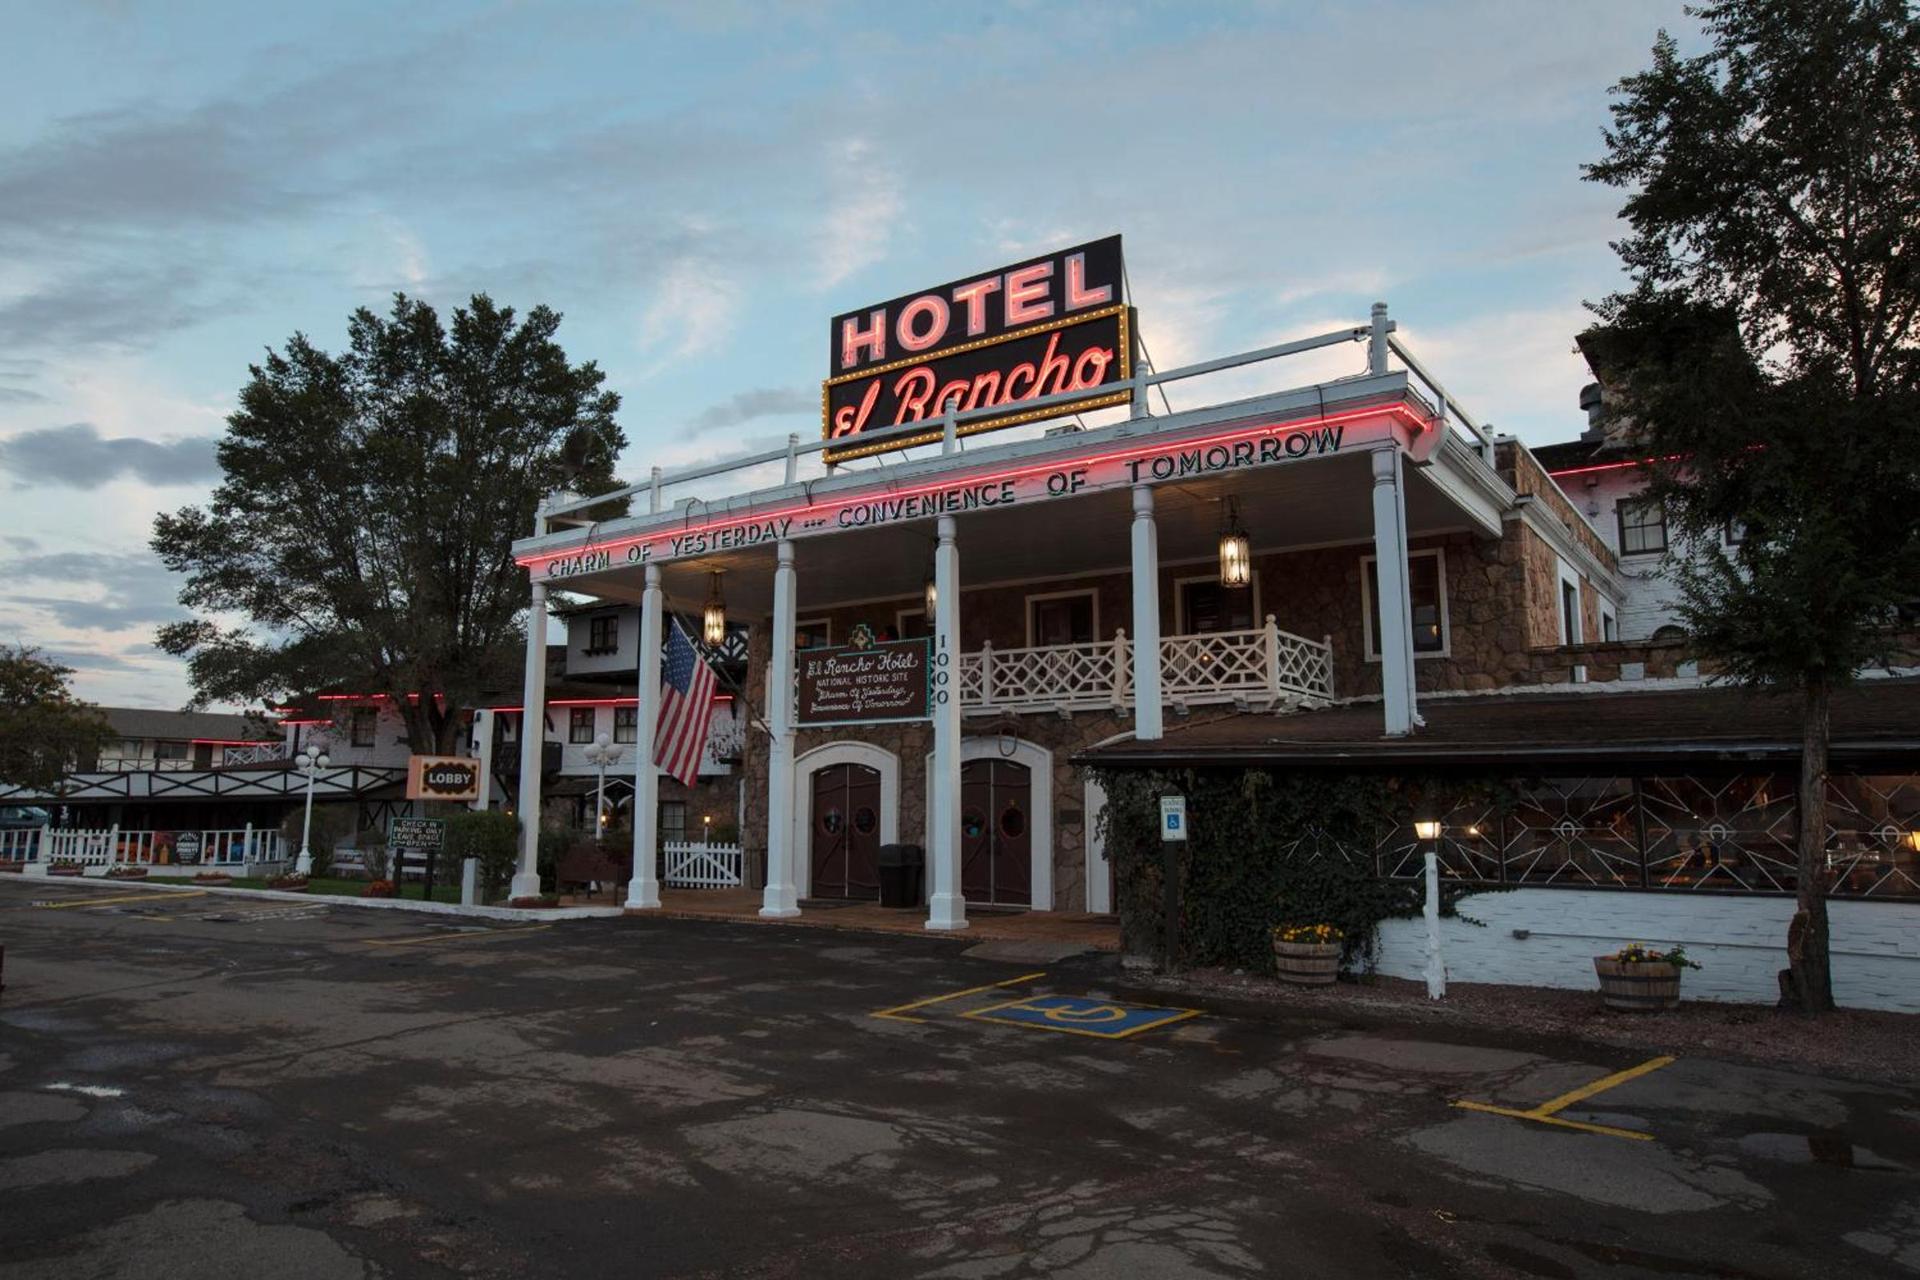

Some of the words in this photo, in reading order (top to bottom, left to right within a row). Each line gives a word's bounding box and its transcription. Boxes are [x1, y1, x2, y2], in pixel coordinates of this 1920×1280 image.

[841, 252, 1112, 369] HOTEL
[831, 379, 881, 440] El
[893, 331, 1114, 428] Rancho
[547, 551, 610, 578] CHARM
[627, 543, 652, 563] OF
[671, 517, 792, 557] YESTERDAY
[838, 480, 1016, 528] CONVENIENCE
[1046, 469, 1089, 496] OF
[1124, 425, 1344, 483] TOMORROW
[807, 660, 823, 679] El
[824, 656, 875, 677] Rancho
[877, 651, 919, 671] Hotel
[936, 634, 949, 705] 1000
[816, 676, 852, 687] NATIONAL
[855, 672, 890, 684] HISTORIC
[892, 672, 909, 681] SITE
[428, 772, 472, 784] LOBBY
[393, 826, 422, 834] PARKING
[401, 820, 427, 828] CHECK
[392, 833, 415, 841] LEAVE
[406, 840, 428, 848] OPEN
